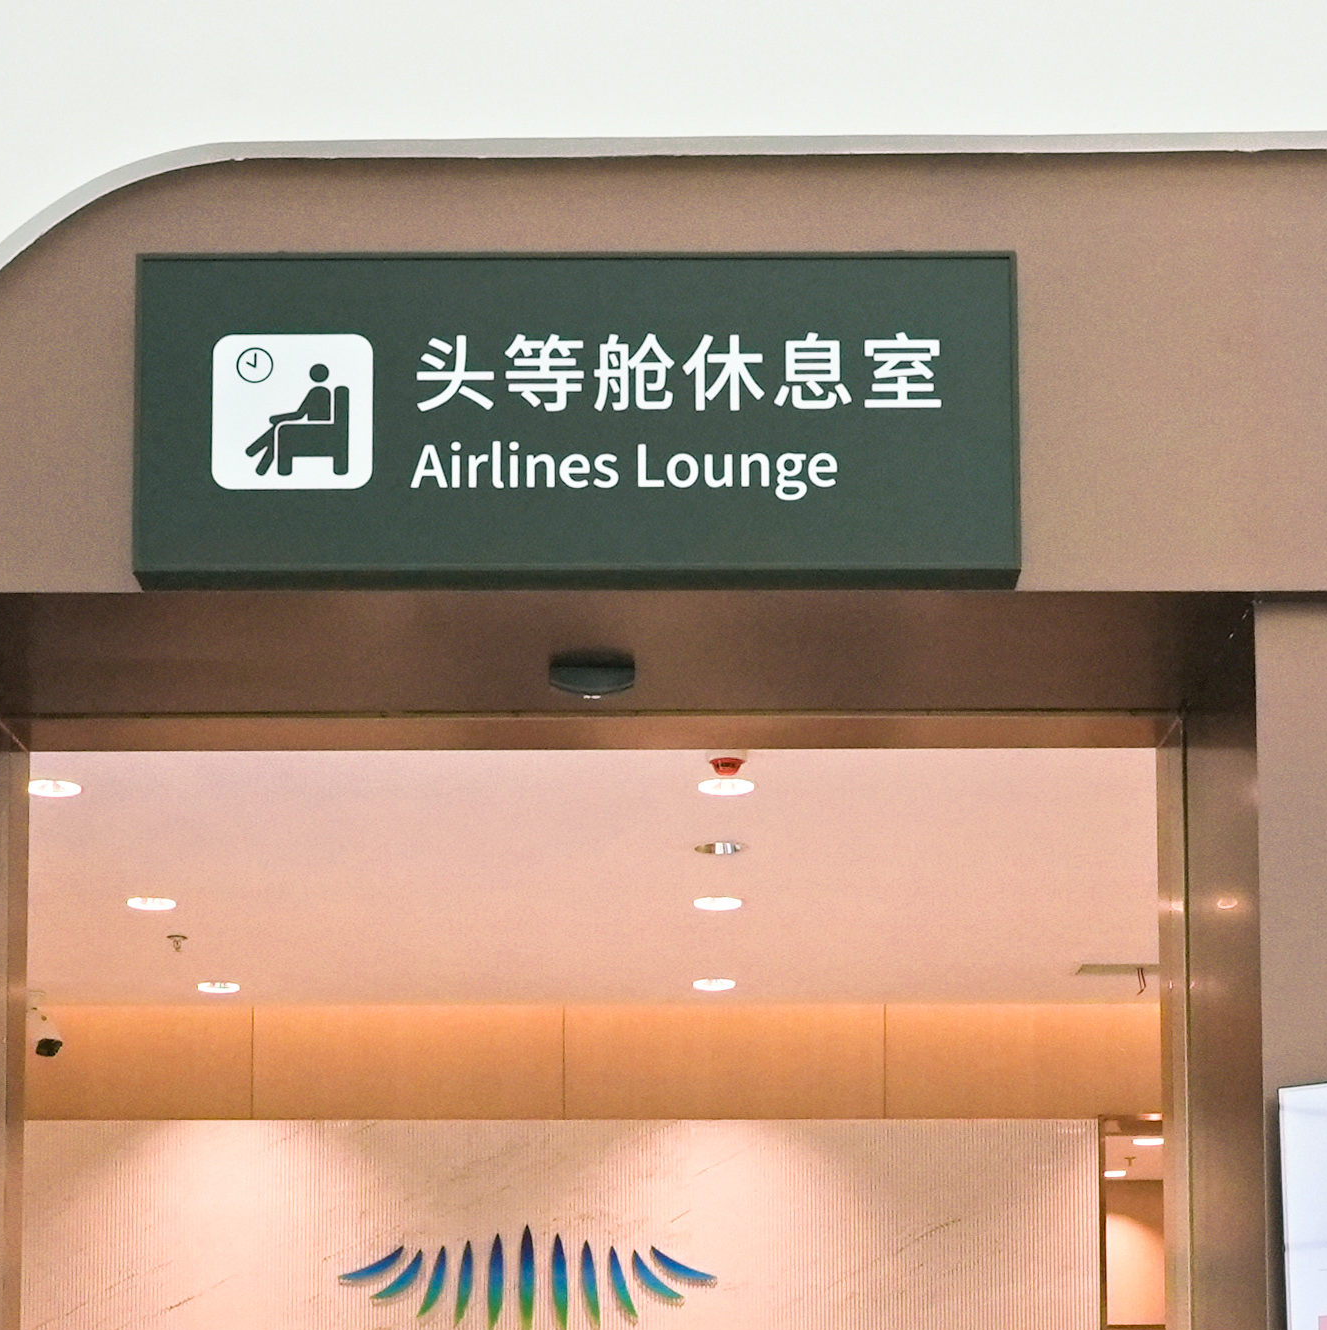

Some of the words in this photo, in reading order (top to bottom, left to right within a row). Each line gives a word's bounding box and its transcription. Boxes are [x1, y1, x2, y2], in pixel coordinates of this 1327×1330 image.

[415, 331, 944, 413] 头等舱休息室
[410, 441, 619, 489] Airlines
[636, 443, 839, 501] Lounge
